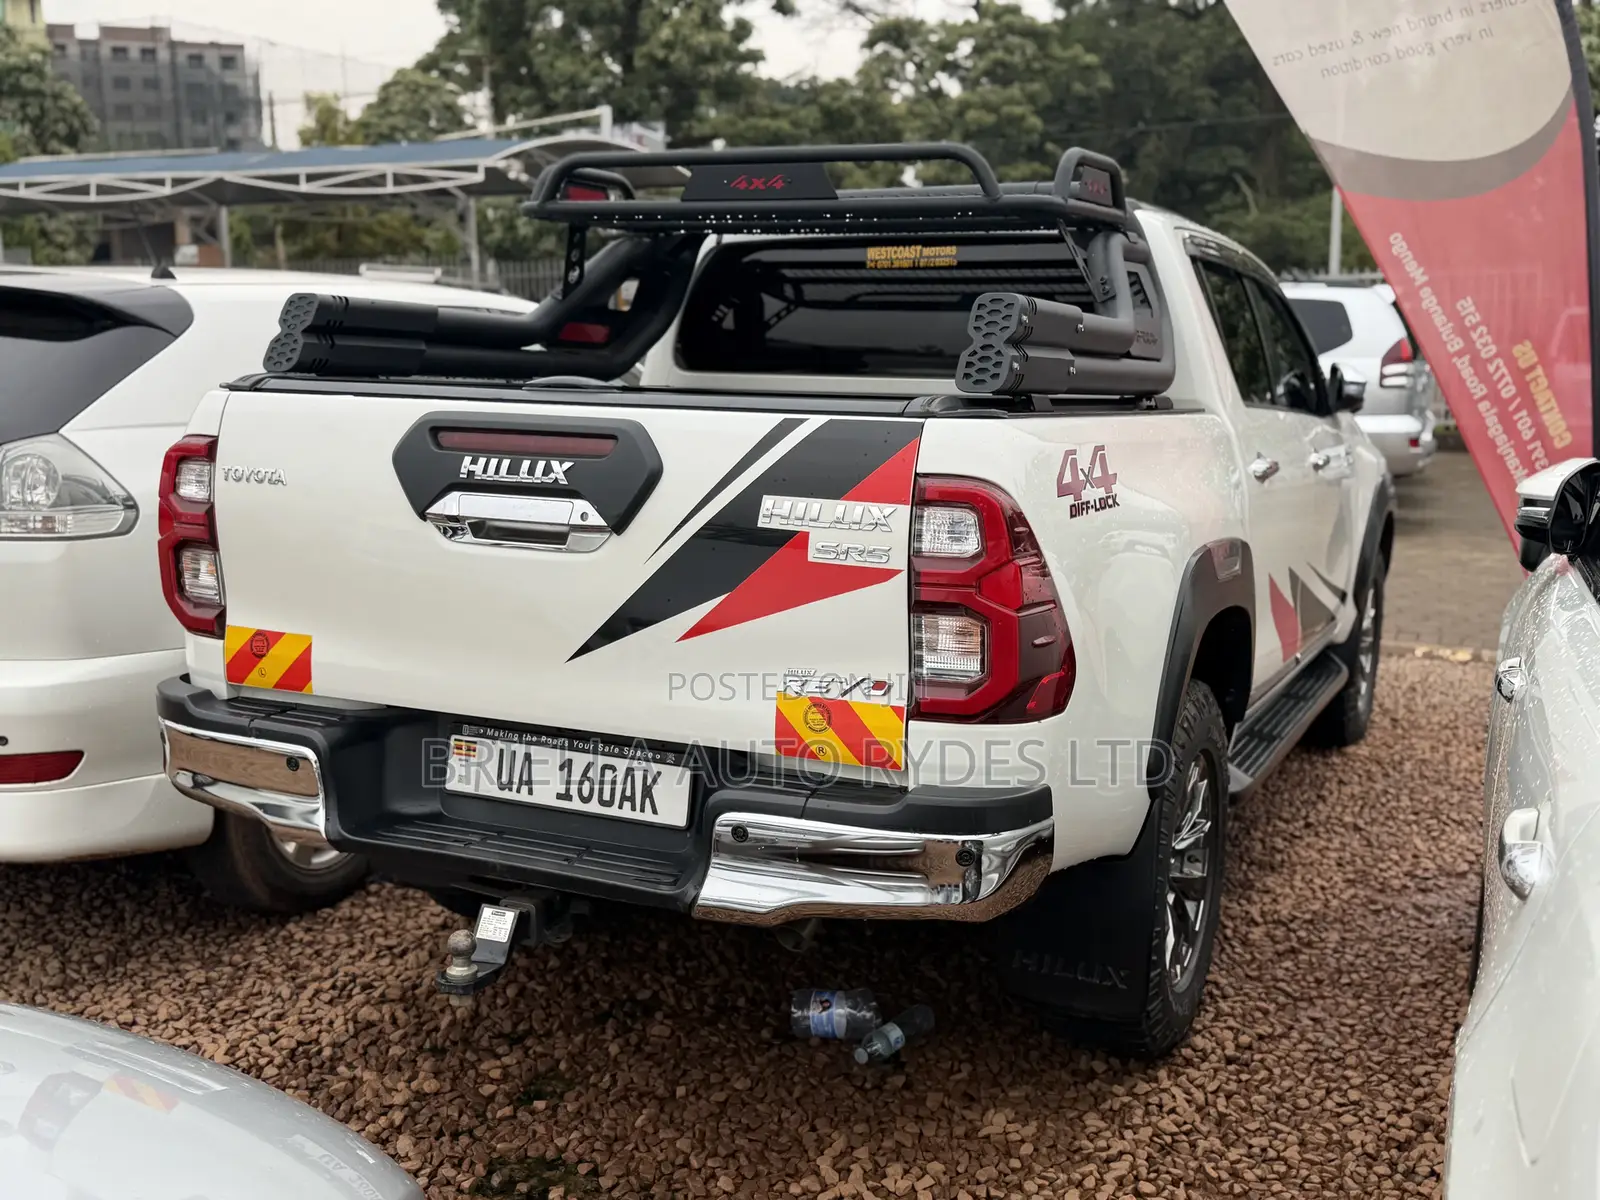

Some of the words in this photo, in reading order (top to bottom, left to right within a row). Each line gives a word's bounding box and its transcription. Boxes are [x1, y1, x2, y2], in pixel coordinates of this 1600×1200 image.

[867, 245, 922, 260] WESTCOAST
[922, 245, 957, 257] MOTORS
[222, 466, 287, 486] TOYOTA
[460, 455, 575, 485] HILUX
[760, 499, 898, 532] HILUX
[812, 540, 892, 563] SR5
[783, 675, 894, 698] REVO
[487, 728, 519, 742] Making
[522, 732, 538, 743] the
[540, 735, 569, 747] Roads
[572, 740, 594, 751] Your
[597, 743, 620, 754] Safe
[623, 746, 654, 759] Space
[496, 747, 534, 796] UA
[556, 758, 663, 816] 160AK
